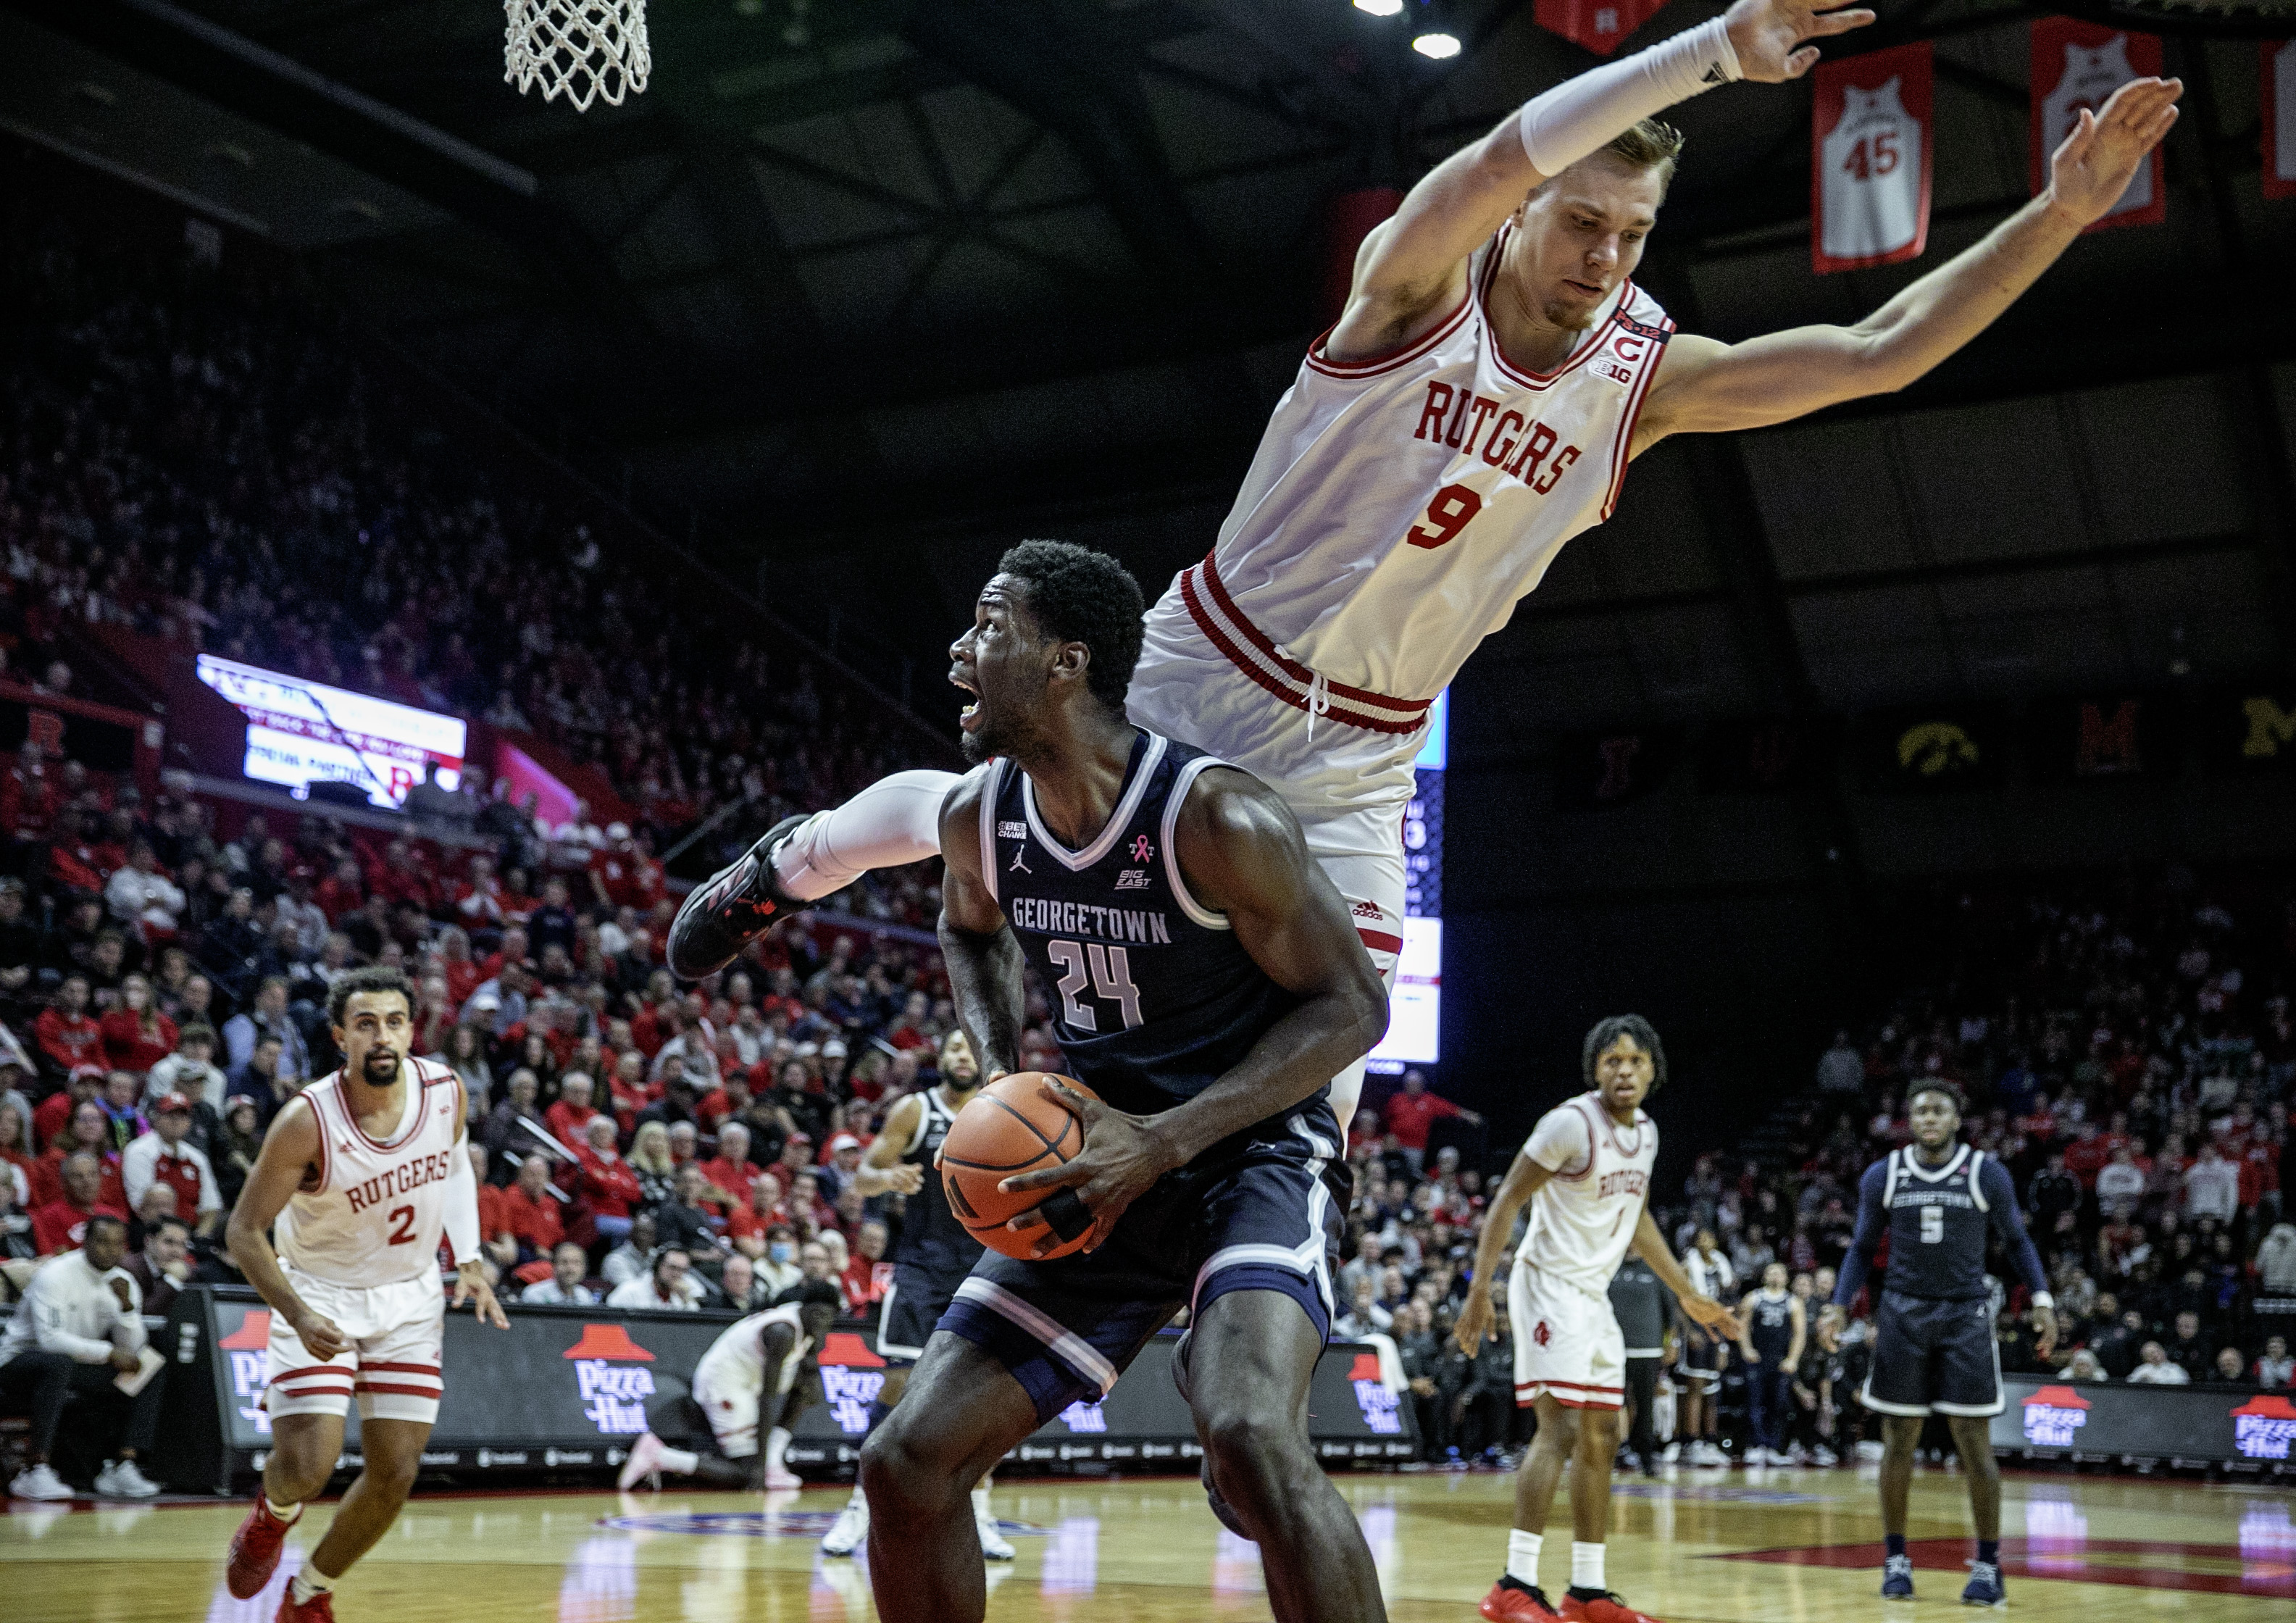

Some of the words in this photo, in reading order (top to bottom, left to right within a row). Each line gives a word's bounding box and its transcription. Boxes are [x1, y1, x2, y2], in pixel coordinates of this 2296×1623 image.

[1843, 130, 1899, 180] 45
[1614, 337, 1645, 362] C
[1414, 380, 1582, 496] RUTGRS
[1407, 483, 1482, 550] 9
[1116, 878, 1152, 887] EAST
[1119, 869, 1145, 878] BIG
[1013, 897, 1172, 944] GEORGETOWN
[1352, 909, 1383, 921] adidas
[1048, 940, 1144, 1032] 24
[344, 1150, 449, 1214] RUTGERS
[388, 1204, 417, 1246] 2
[1920, 1206, 1944, 1244] 5
[574, 1358, 657, 1401] Pizza
[583, 1393, 651, 1435] Hut
